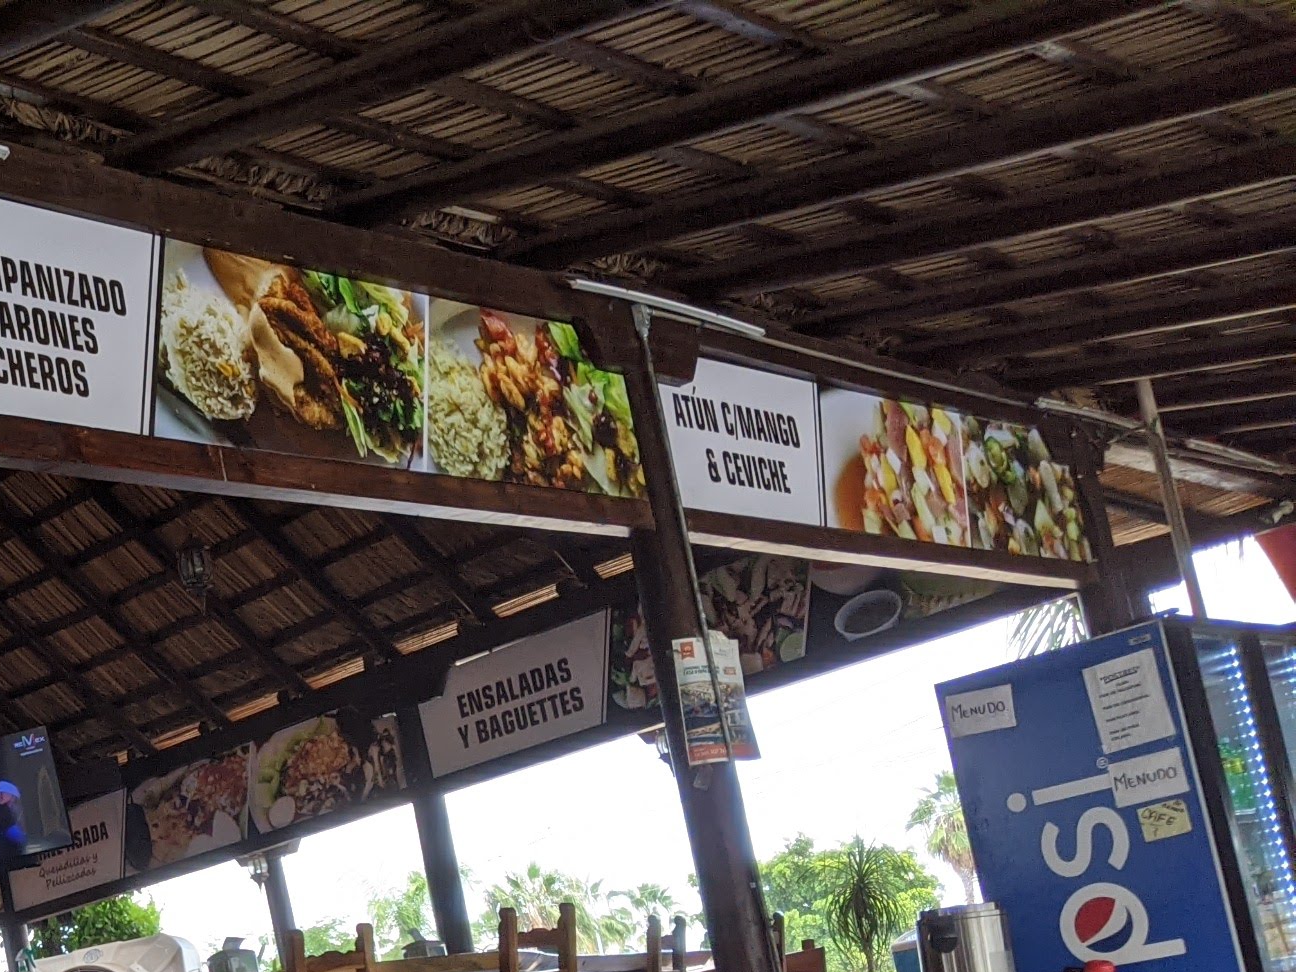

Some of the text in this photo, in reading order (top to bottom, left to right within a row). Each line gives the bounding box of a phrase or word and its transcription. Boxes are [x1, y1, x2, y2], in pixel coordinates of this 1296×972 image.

[672, 386, 801, 448] ATÚN C/MANGO
[705, 448, 792, 494] & CEVICHE
[456, 657, 572, 719] ENSALADAS
[457, 686, 585, 749] Y BAGUETTES
[1113, 766, 1177, 791] MENUDO
